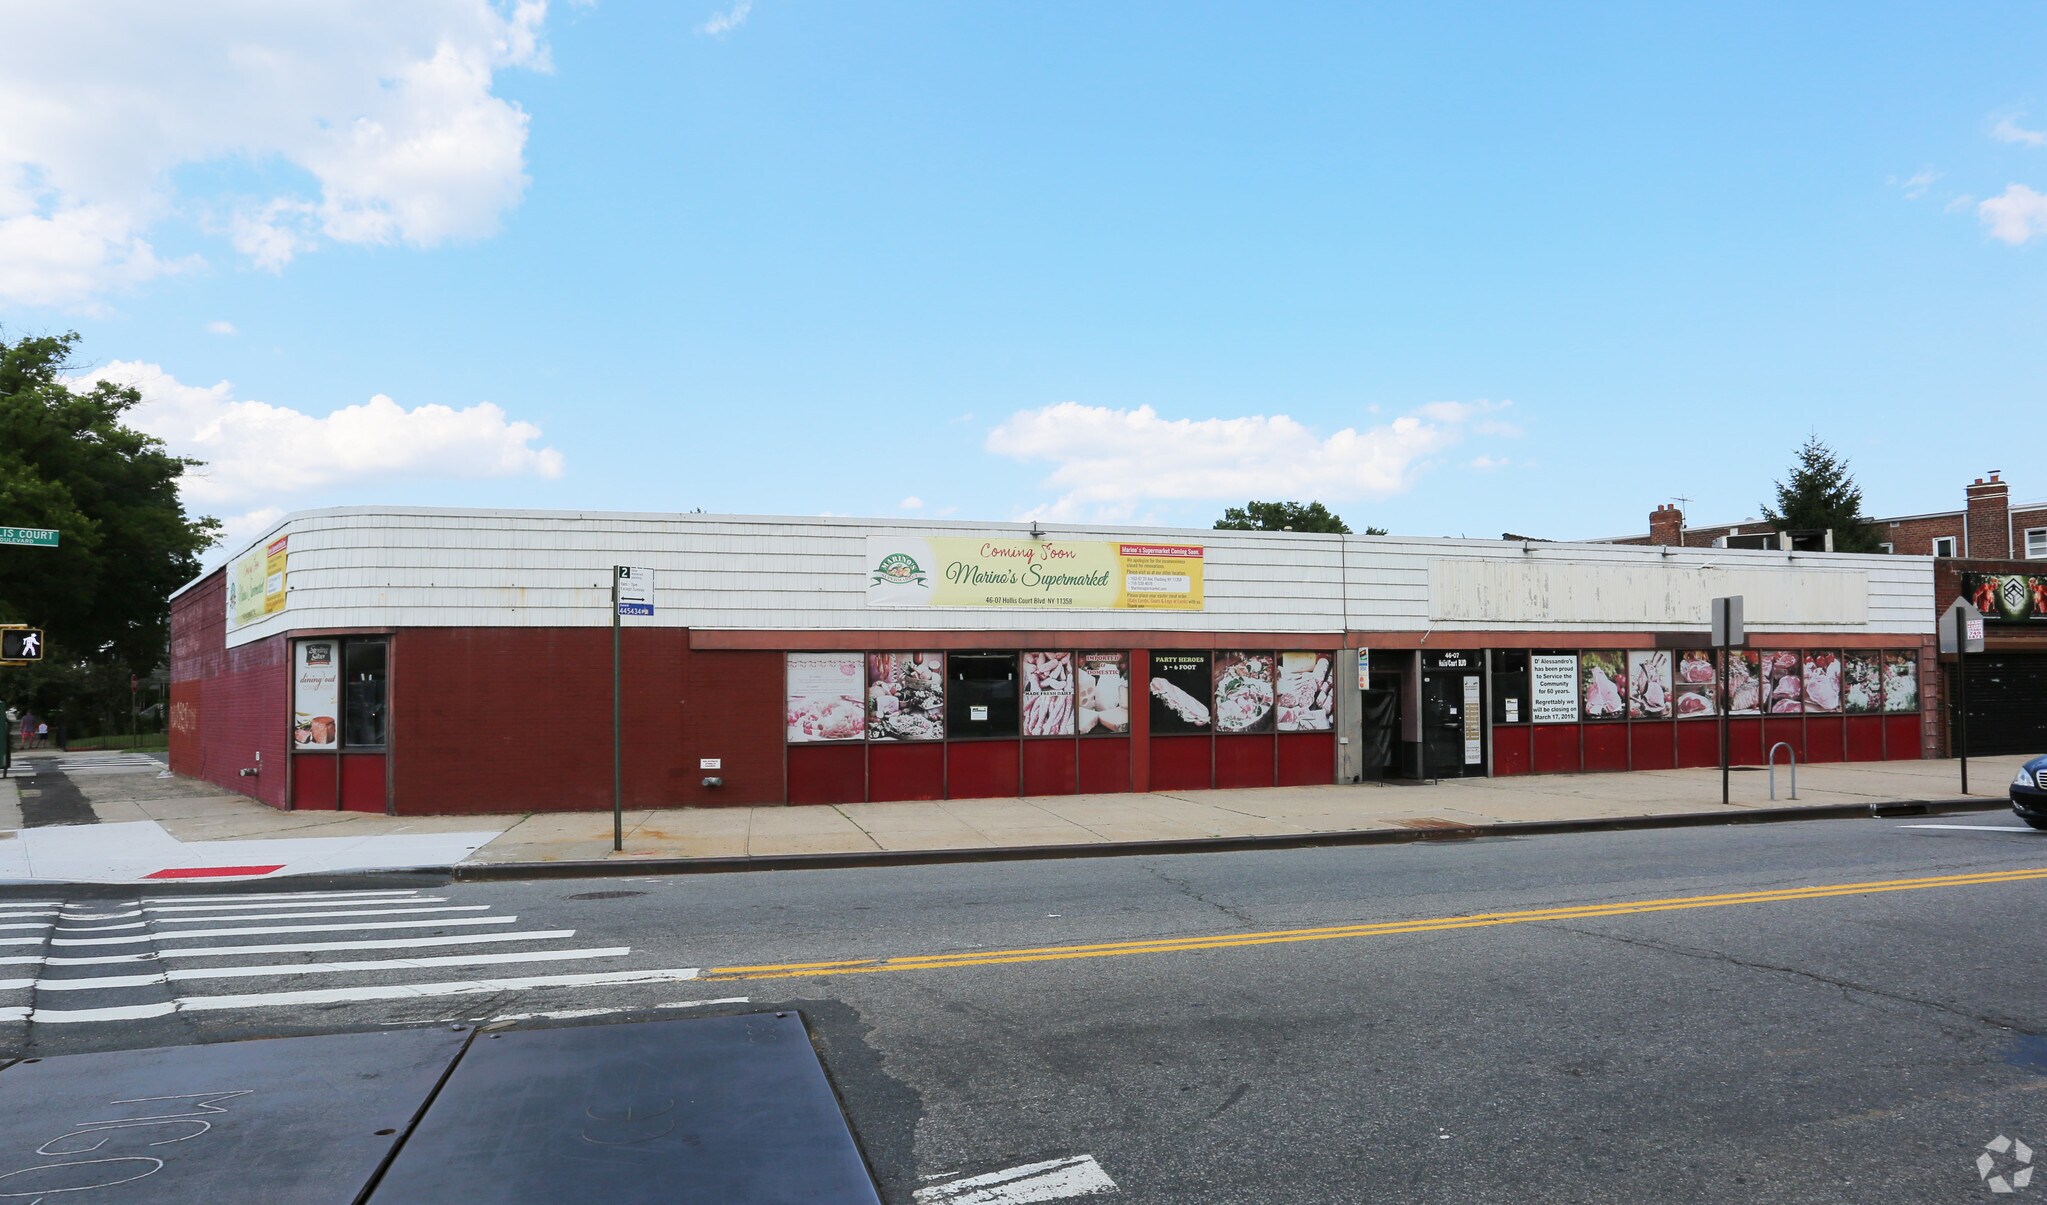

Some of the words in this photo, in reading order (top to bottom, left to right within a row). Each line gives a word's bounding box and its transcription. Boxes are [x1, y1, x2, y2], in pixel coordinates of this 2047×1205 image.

[19, 530, 54, 540] COURT
[980, 543, 1035, 564] Coming
[1041, 543, 1076, 560] Soon
[1171, 548, 1187, 556] Coming
[621, 567, 628, 578] 2
[946, 562, 1018, 586] Marino's
[1021, 563, 1109, 591] Supermarket
